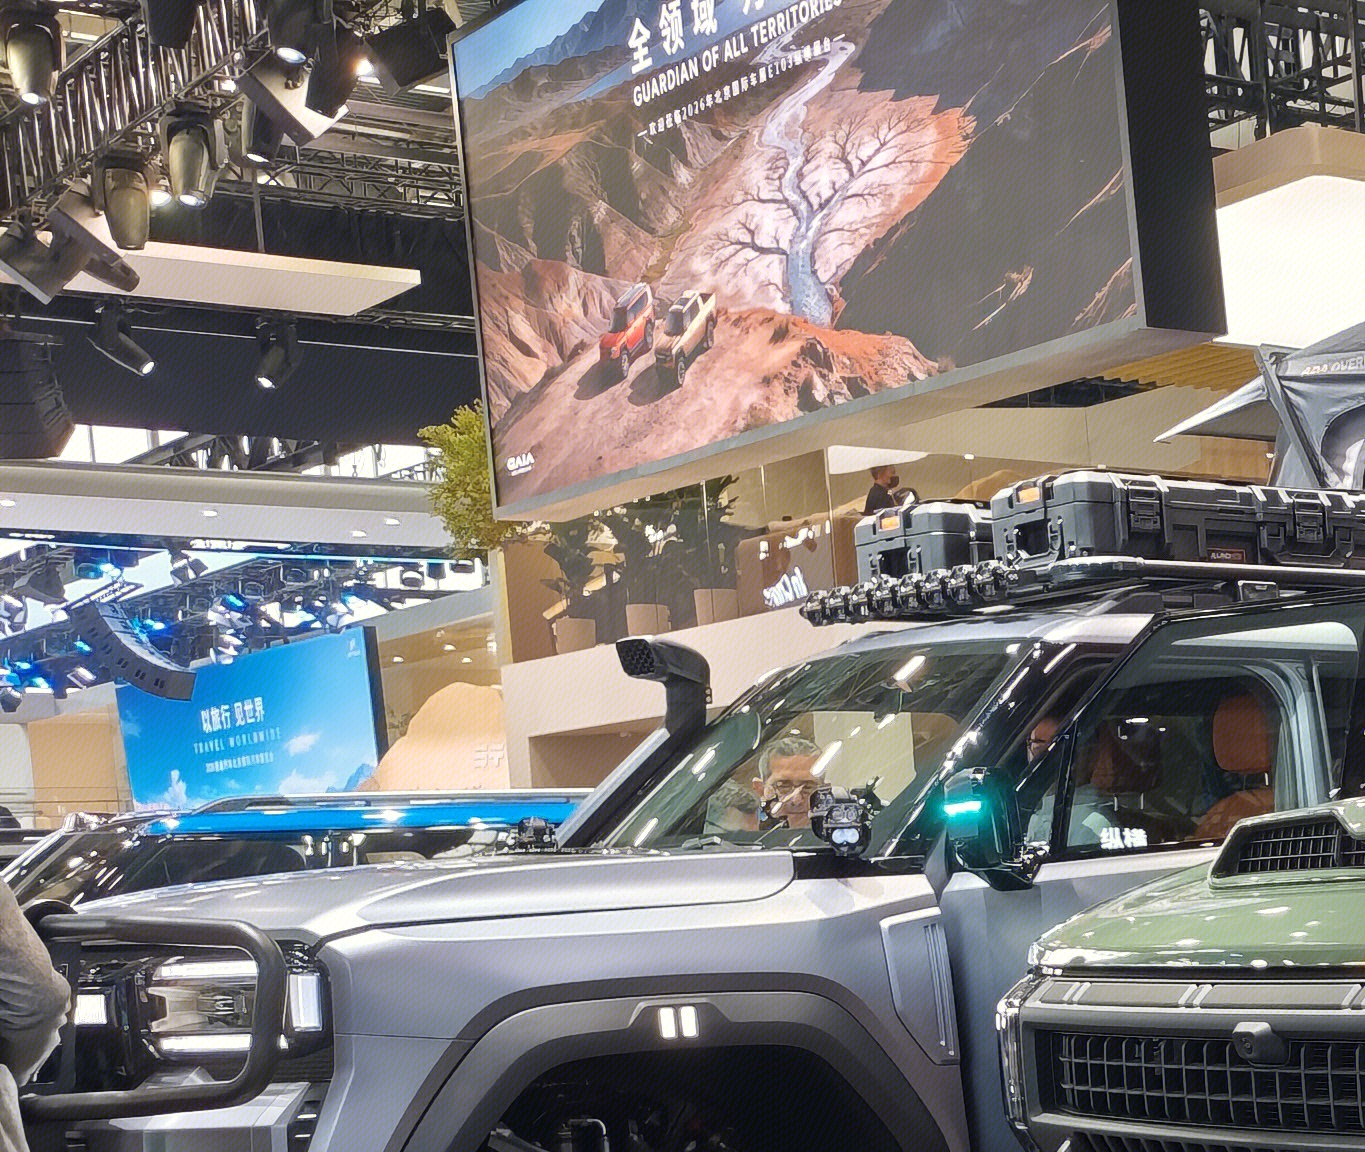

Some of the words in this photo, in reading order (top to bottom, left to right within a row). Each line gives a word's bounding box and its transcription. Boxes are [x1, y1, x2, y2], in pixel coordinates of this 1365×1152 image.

[633, 56, 699, 107] GUARDIAN
[702, 45, 720, 72] OF
[724, 33, 749, 63] ALL
[193, 738, 225, 755] TRAVEL
